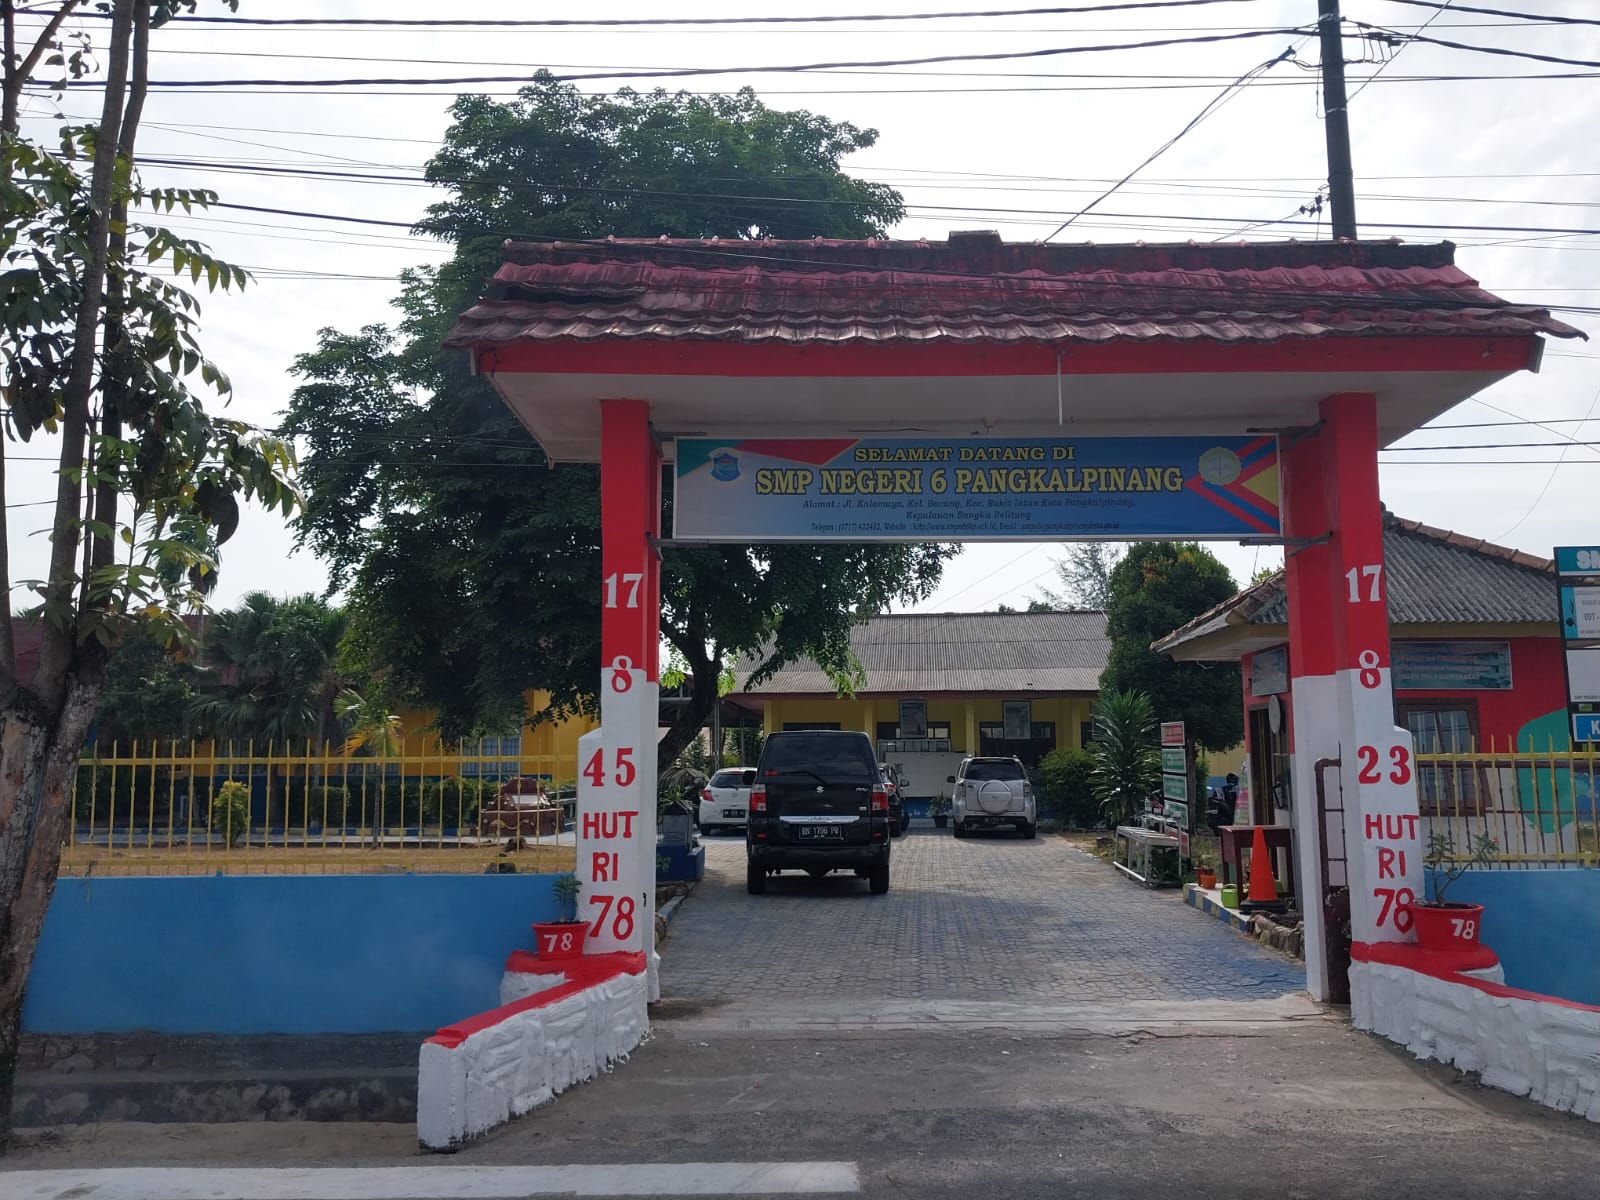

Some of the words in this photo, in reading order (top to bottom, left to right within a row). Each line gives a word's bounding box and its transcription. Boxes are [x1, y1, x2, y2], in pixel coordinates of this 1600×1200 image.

[854, 447, 953, 463] SELAMAT
[959, 446, 1046, 462] DATANG
[1051, 446, 1075, 461] DI
[755, 467, 813, 495] SMP
[819, 467, 923, 495] NEGERI
[930, 468, 947, 495] 6
[954, 466, 1184, 494] PANGKALPINANG
[802, 499, 834, 508] Alamat
[906, 511, 954, 521] Kepulauan
[957, 511, 991, 521] Bangka
[994, 511, 1032, 521] Belitung
[604, 572, 643, 609] 17
[1345, 563, 1382, 603] 17
[611, 654, 633, 693] 8
[1359, 649, 1381, 690] 8
[582, 811, 639, 840] HUT
[1365, 813, 1420, 842] HUT
[592, 851, 619, 882] RI
[1378, 848, 1407, 880] RI
[588, 894, 635, 941] 78
[1373, 888, 1415, 935] 78
[543, 932, 573, 952] 78
[1450, 918, 1476, 941] 78
